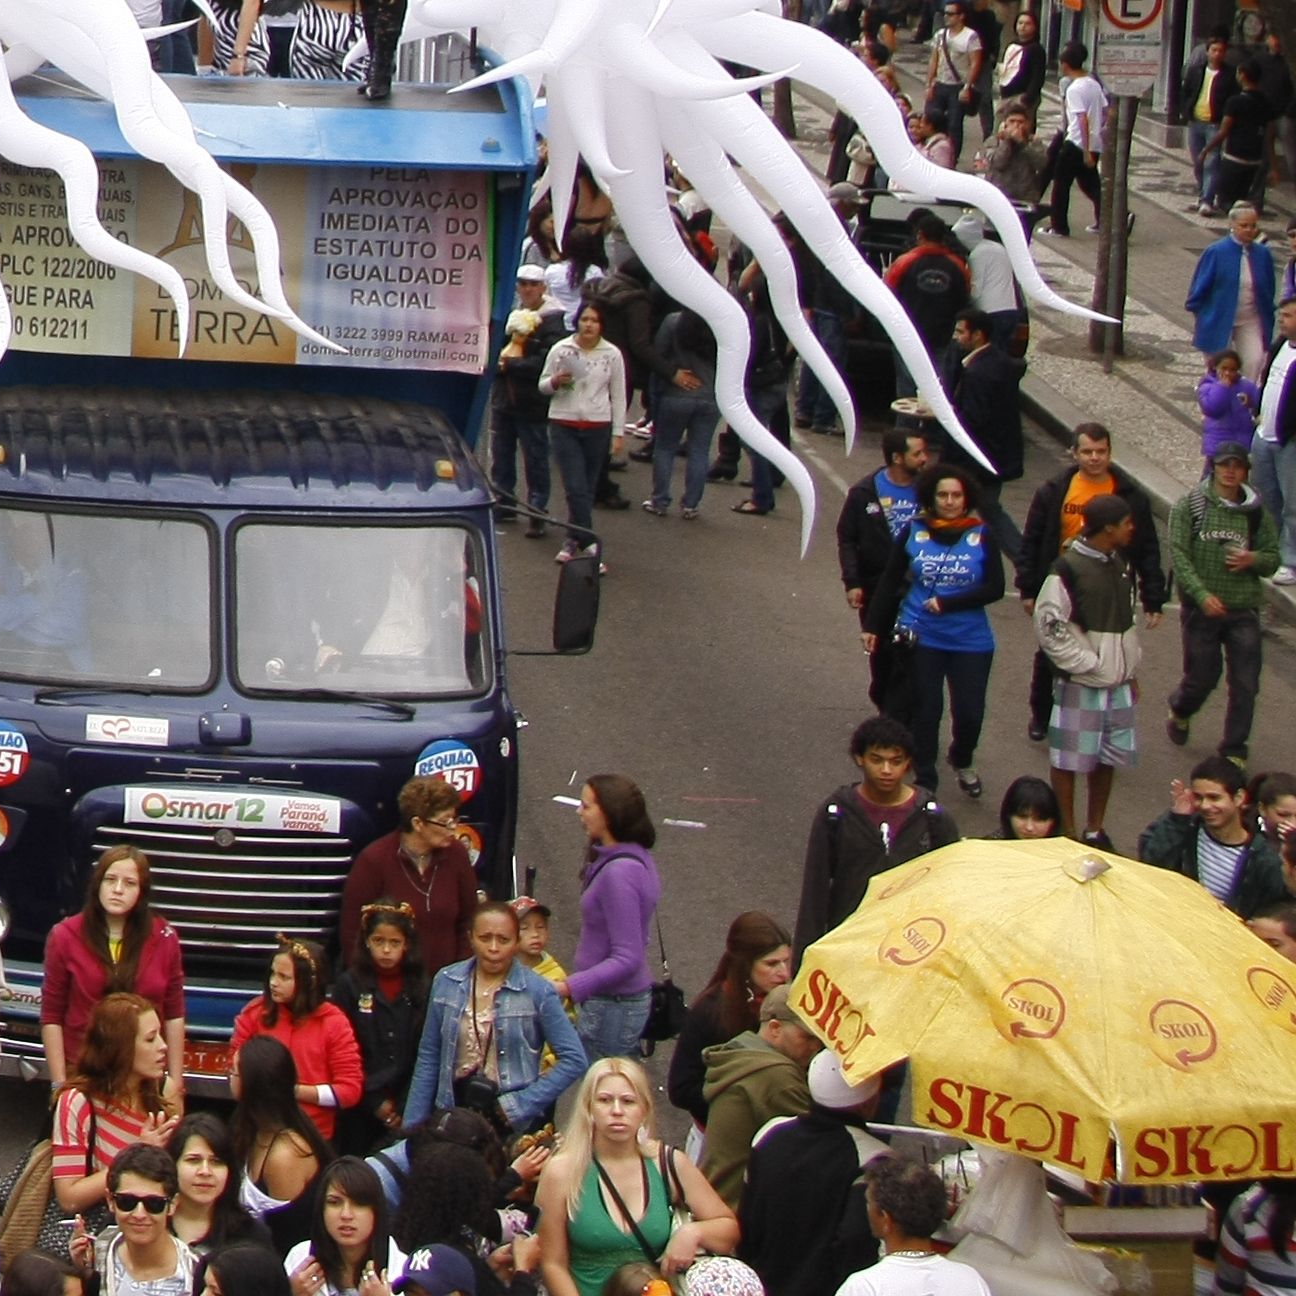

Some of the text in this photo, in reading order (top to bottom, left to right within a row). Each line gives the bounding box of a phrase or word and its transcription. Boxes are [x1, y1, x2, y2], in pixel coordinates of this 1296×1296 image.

[370, 168, 431, 183] PELA
[18, 184, 55, 200] GAYS,
[329, 188, 479, 213] APROVAÇÃO
[29, 204, 36, 217] E
[12, 224, 129, 248] APROVO
[320, 212, 479, 236] IMEDIATA DO
[313, 238, 483, 261] ESTATUTO DA
[1, 254, 116, 281] PLC 122/2006
[326, 263, 464, 286] IGUALDADE
[3, 284, 94, 309] GUE PARA
[350, 289, 437, 310] RACIAL
[29, 317, 88, 340] 612211
[150, 308, 278, 346] TERRA
[335, 326, 367, 340] 3222
[371, 328, 404, 342] 3999
[408, 330, 459, 344] RAMAL
[464, 332, 480, 346] 23
[442, 770, 474, 791] 151
[141, 792, 266, 822] Osmar 12
[902, 925, 931, 957] SKOL
[799, 969, 877, 1071] SKOL
[1008, 995, 1056, 1024] SKOL
[1159, 1021, 1207, 1039] SKOL
[926, 1077, 1087, 1171] SKOL
[1134, 1121, 1294, 1178] SKOL
